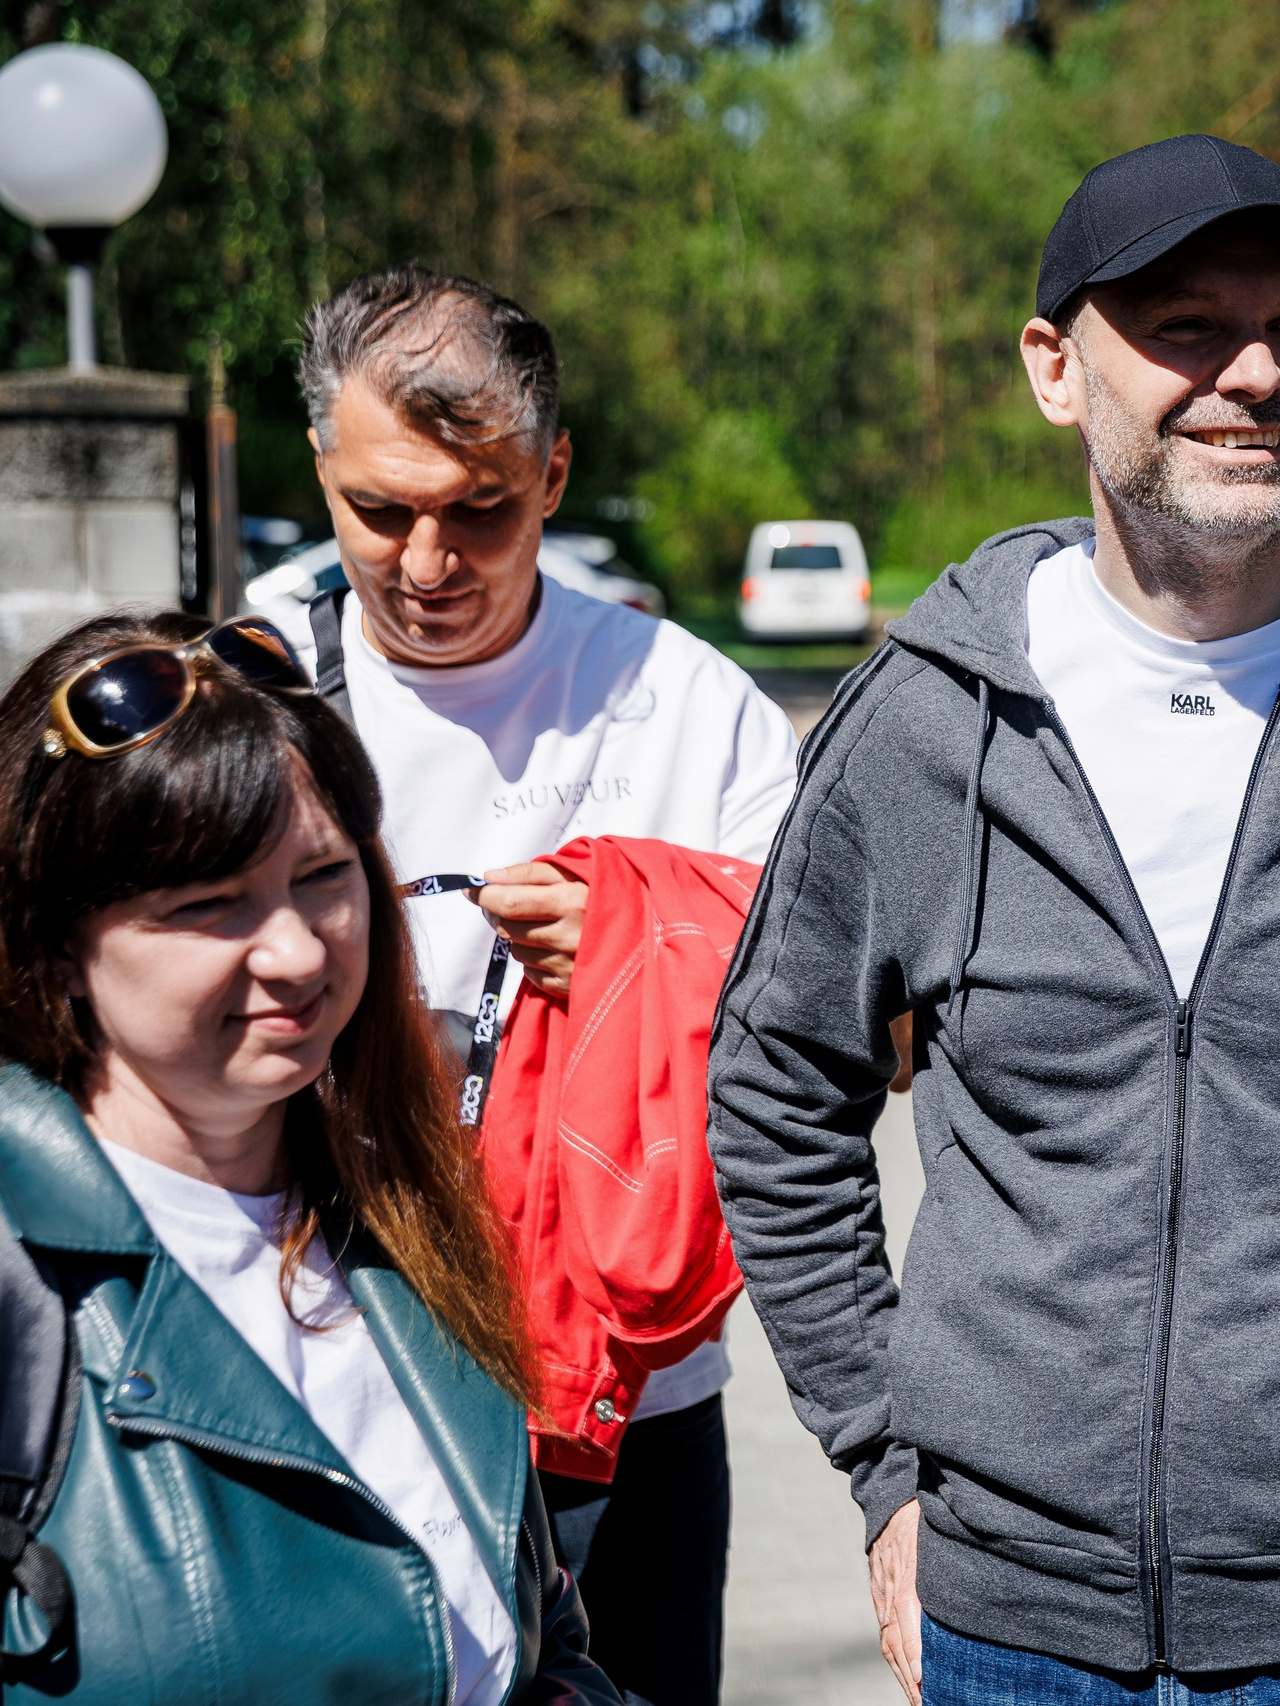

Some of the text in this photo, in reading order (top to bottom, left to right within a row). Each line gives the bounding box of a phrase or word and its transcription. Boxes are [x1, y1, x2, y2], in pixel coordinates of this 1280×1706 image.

[1171, 693, 1215, 710] KARL
[1170, 706, 1215, 716] LAGERFELD
[493, 777, 632, 819] SAUVEUR
